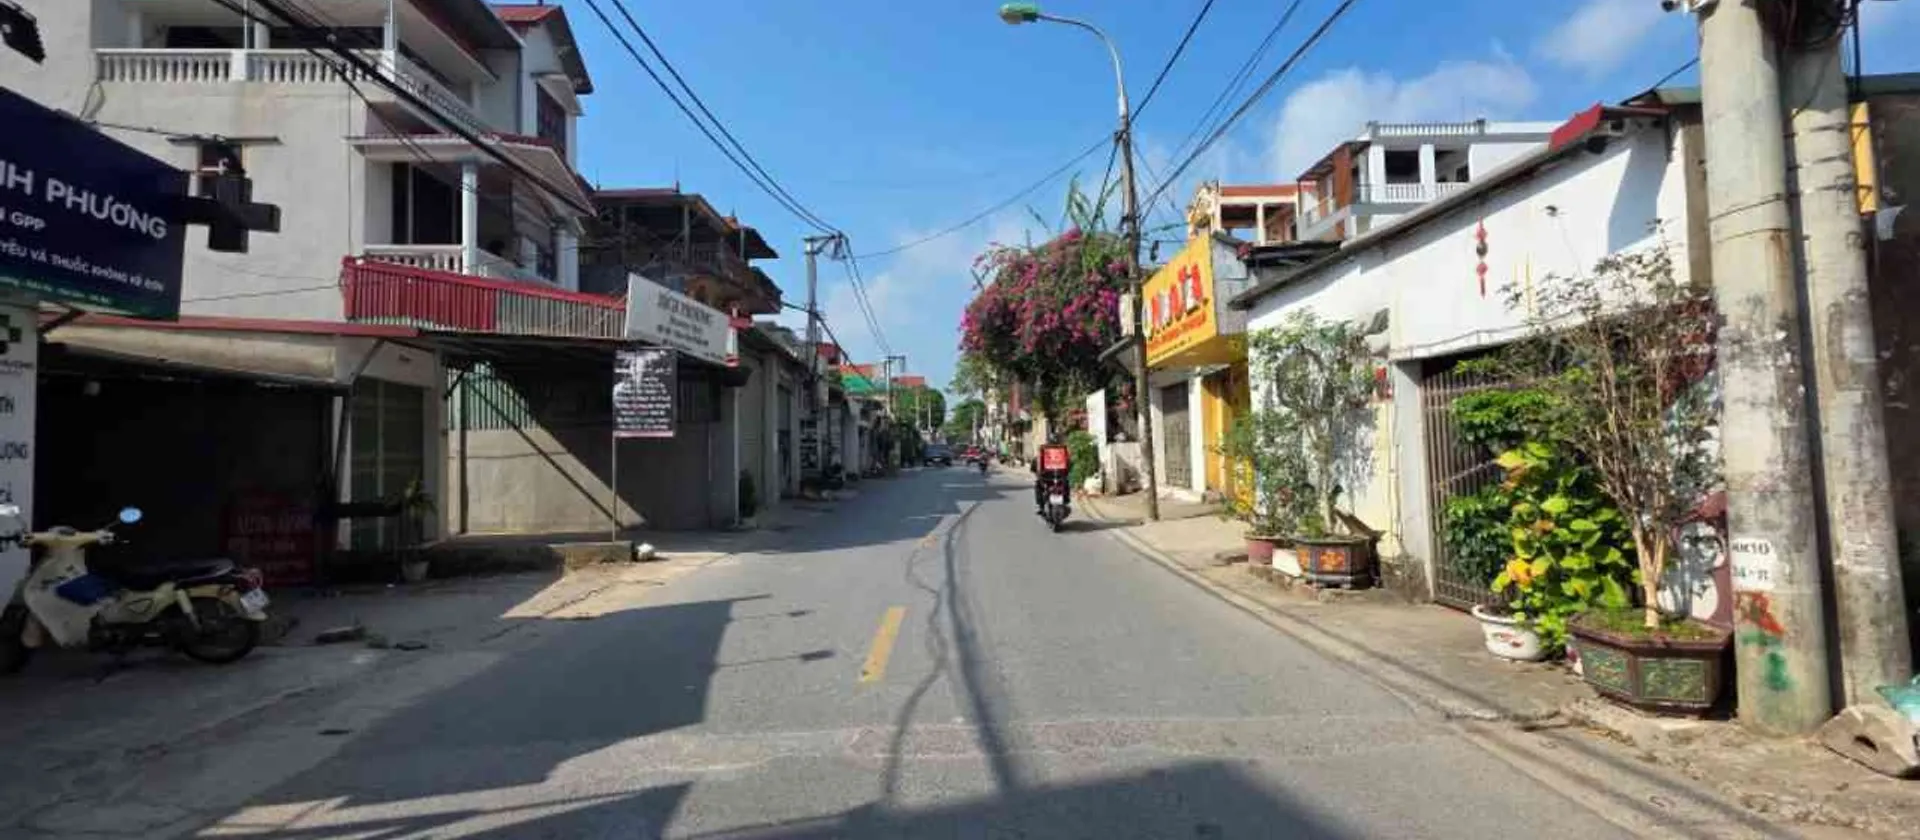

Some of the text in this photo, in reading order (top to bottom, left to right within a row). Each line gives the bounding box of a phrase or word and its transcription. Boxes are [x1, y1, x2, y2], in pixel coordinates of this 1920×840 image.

[0, 160, 168, 239] H PHƯƠNG
[11, 211, 46, 231] GPP
